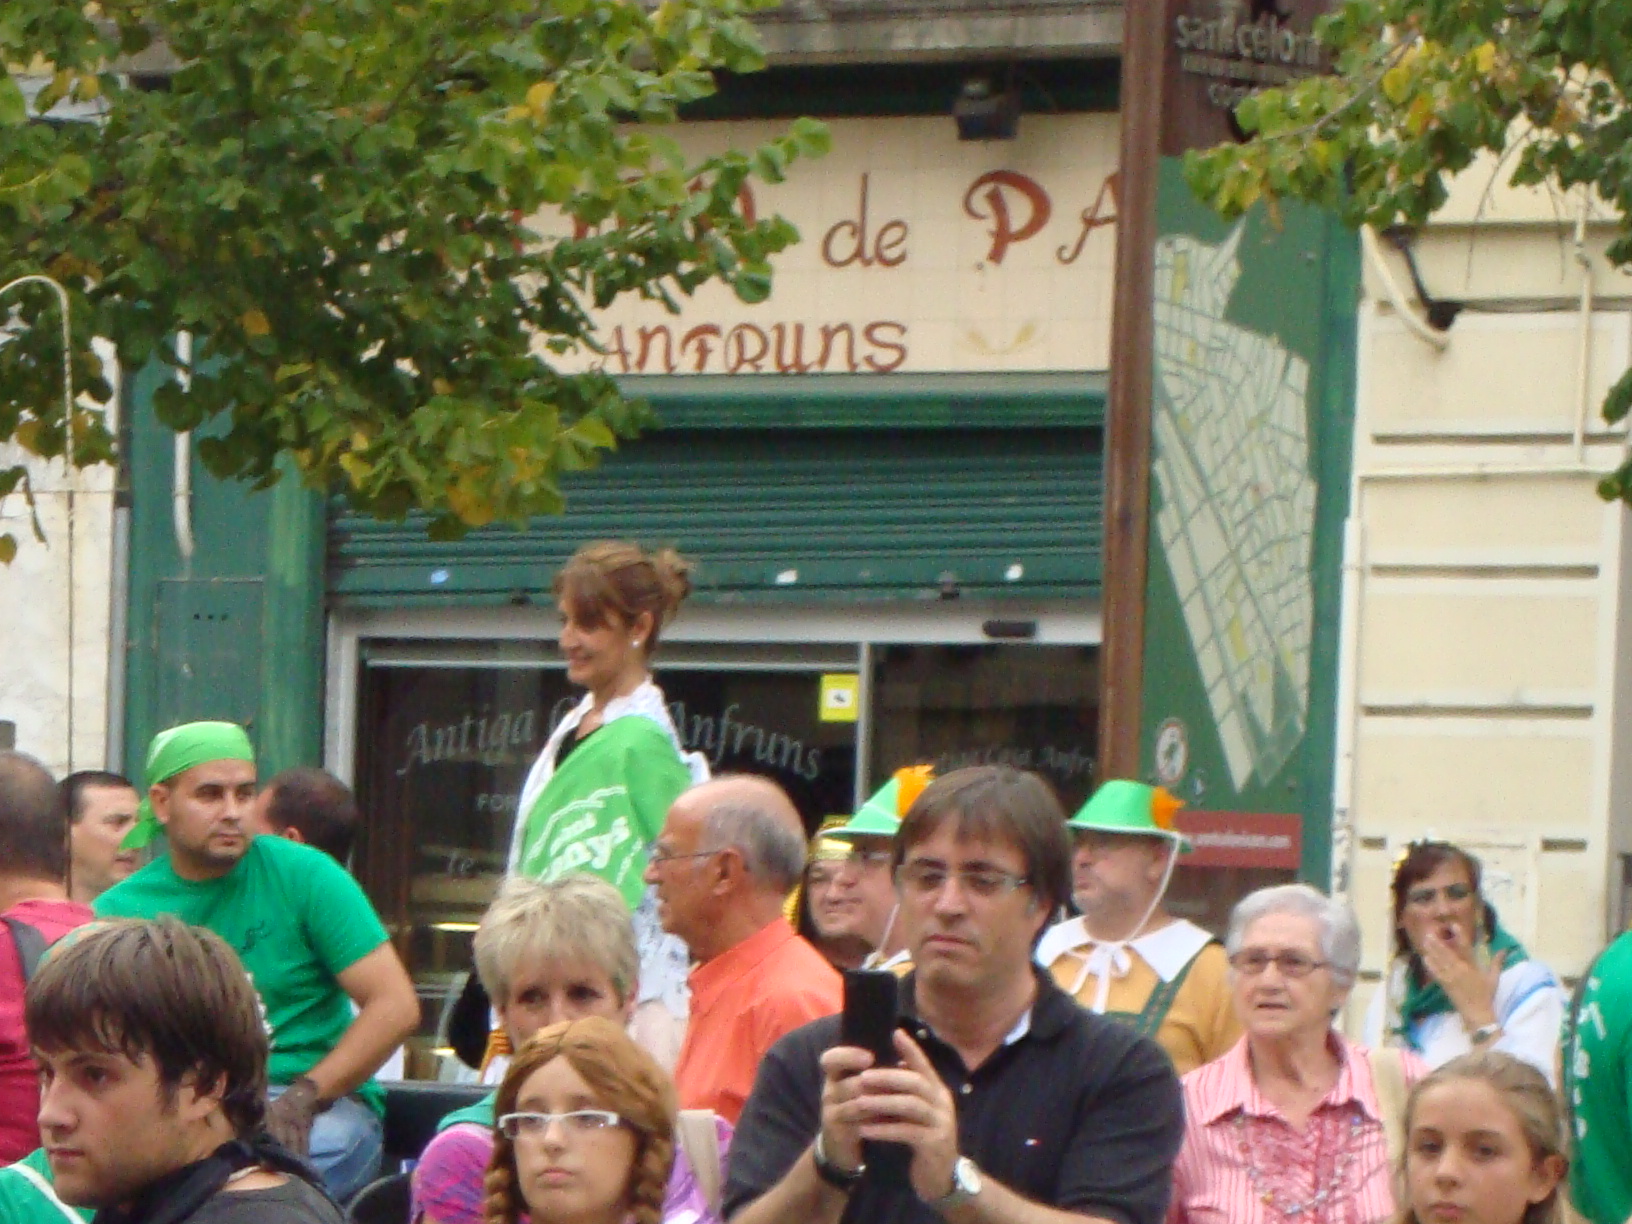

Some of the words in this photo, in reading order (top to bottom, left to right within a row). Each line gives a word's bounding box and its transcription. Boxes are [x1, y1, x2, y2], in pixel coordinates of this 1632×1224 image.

[821, 172, 911, 268] de
[396, 702, 535, 776] Antiga
[669, 699, 822, 781] Anfruns
